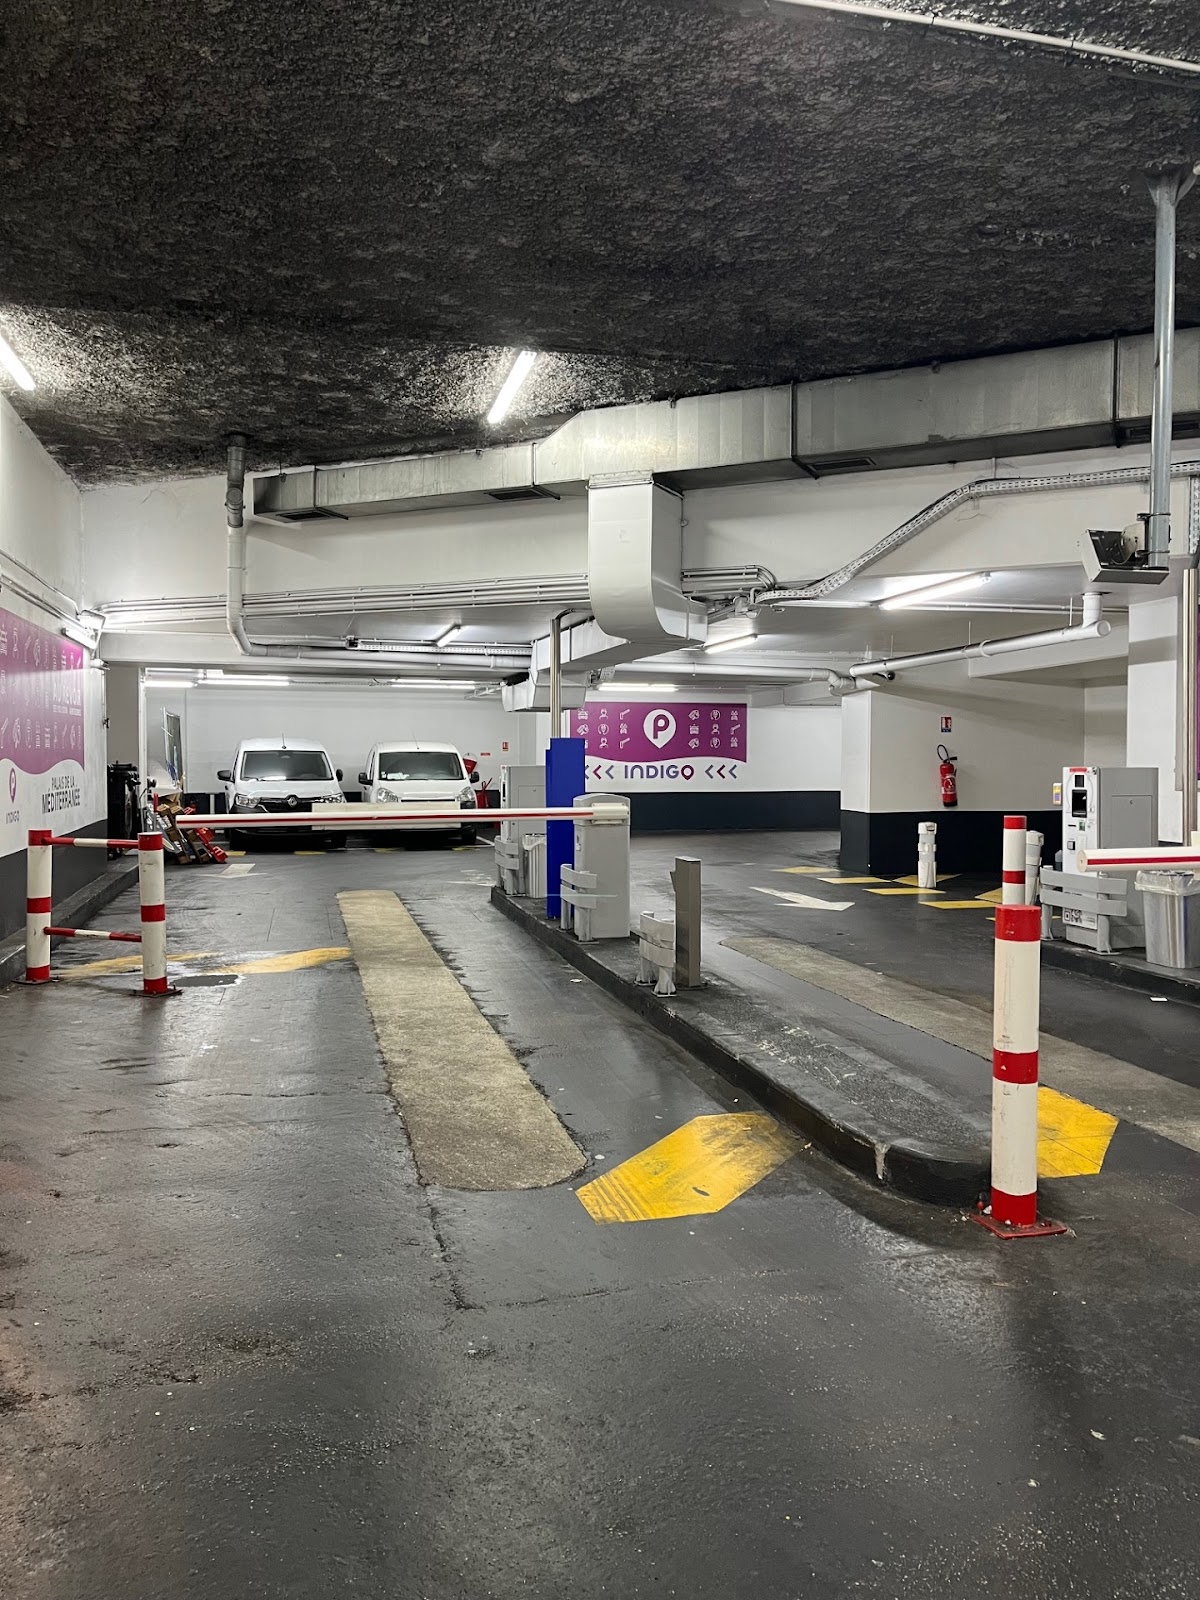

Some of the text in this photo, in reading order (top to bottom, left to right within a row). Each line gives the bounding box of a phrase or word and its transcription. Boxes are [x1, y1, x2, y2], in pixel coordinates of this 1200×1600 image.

[653, 714, 669, 739] P
[624, 764, 694, 780] INDIGO
[52, 775, 75, 790] PALAIS DE LA
